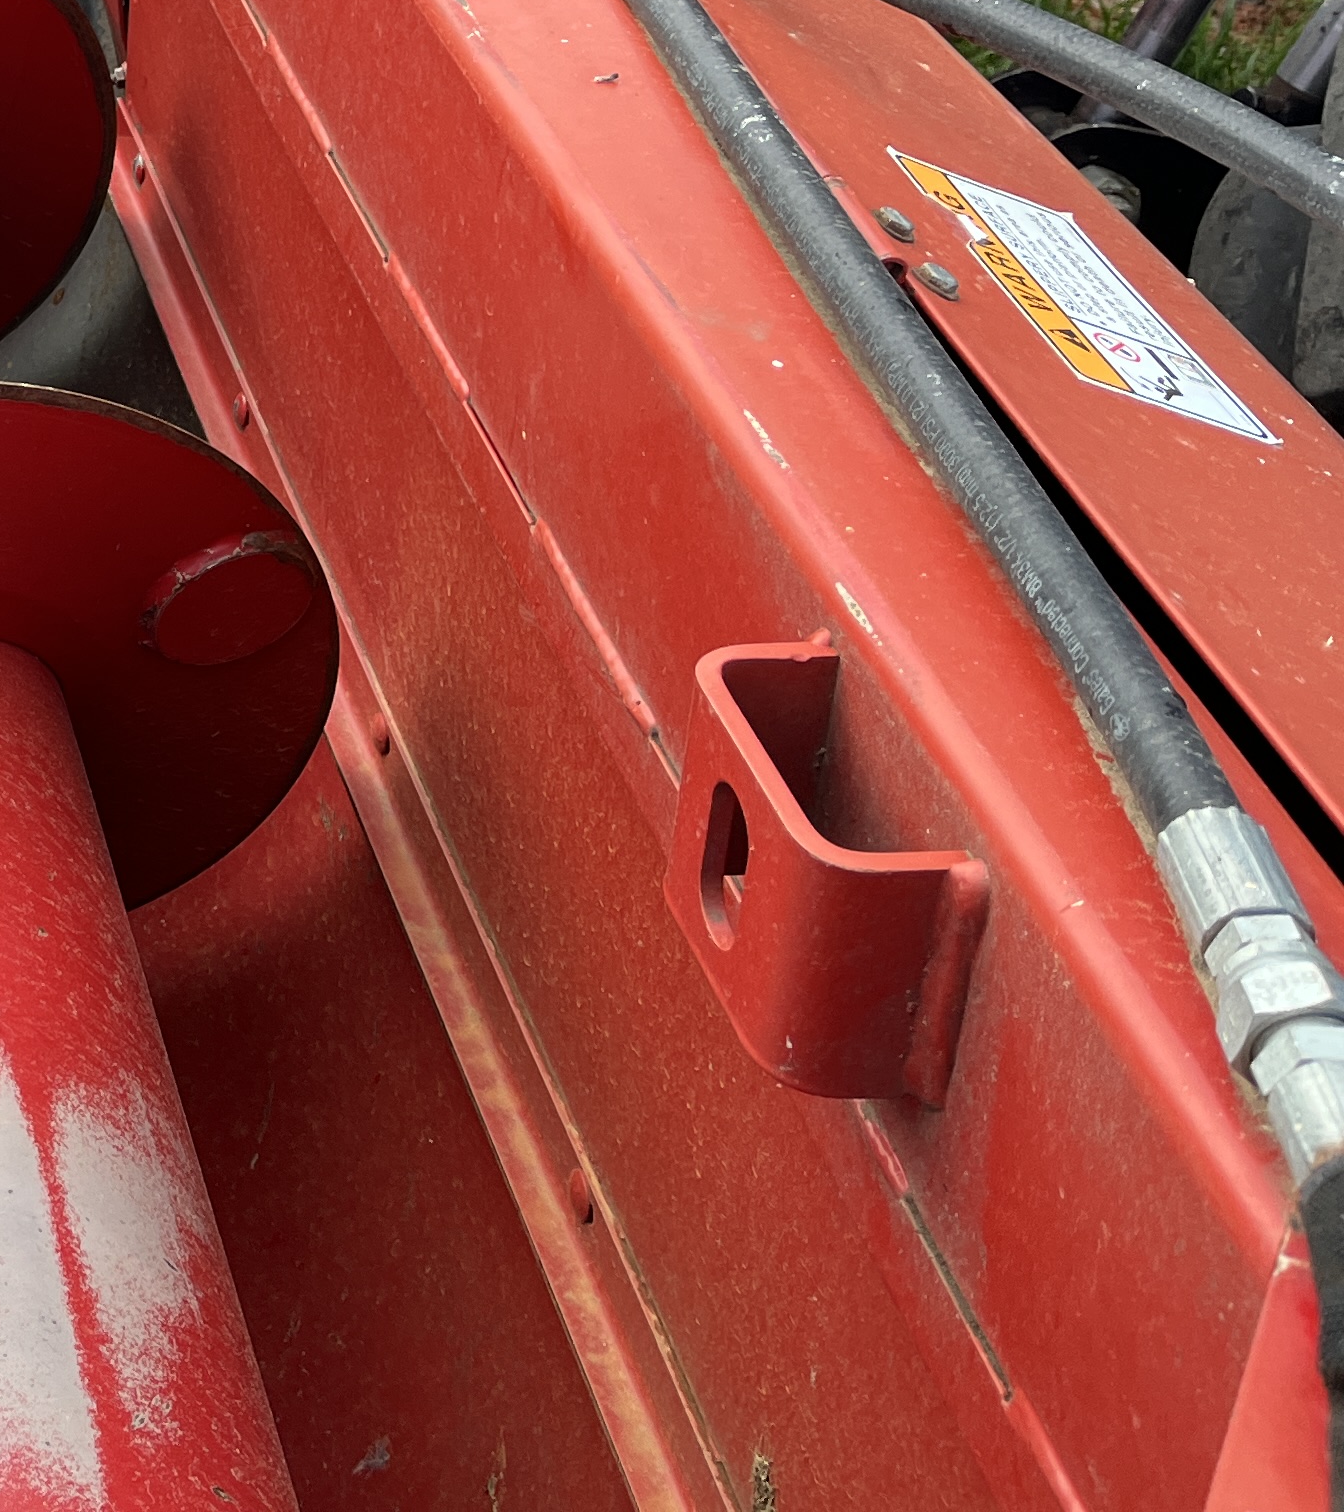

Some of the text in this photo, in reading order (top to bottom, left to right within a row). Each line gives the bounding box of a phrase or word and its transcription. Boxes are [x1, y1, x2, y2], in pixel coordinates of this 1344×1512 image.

[928, 187, 1058, 316] WARNG
[965, 191, 1082, 314] SLIPPERY SURFACE
